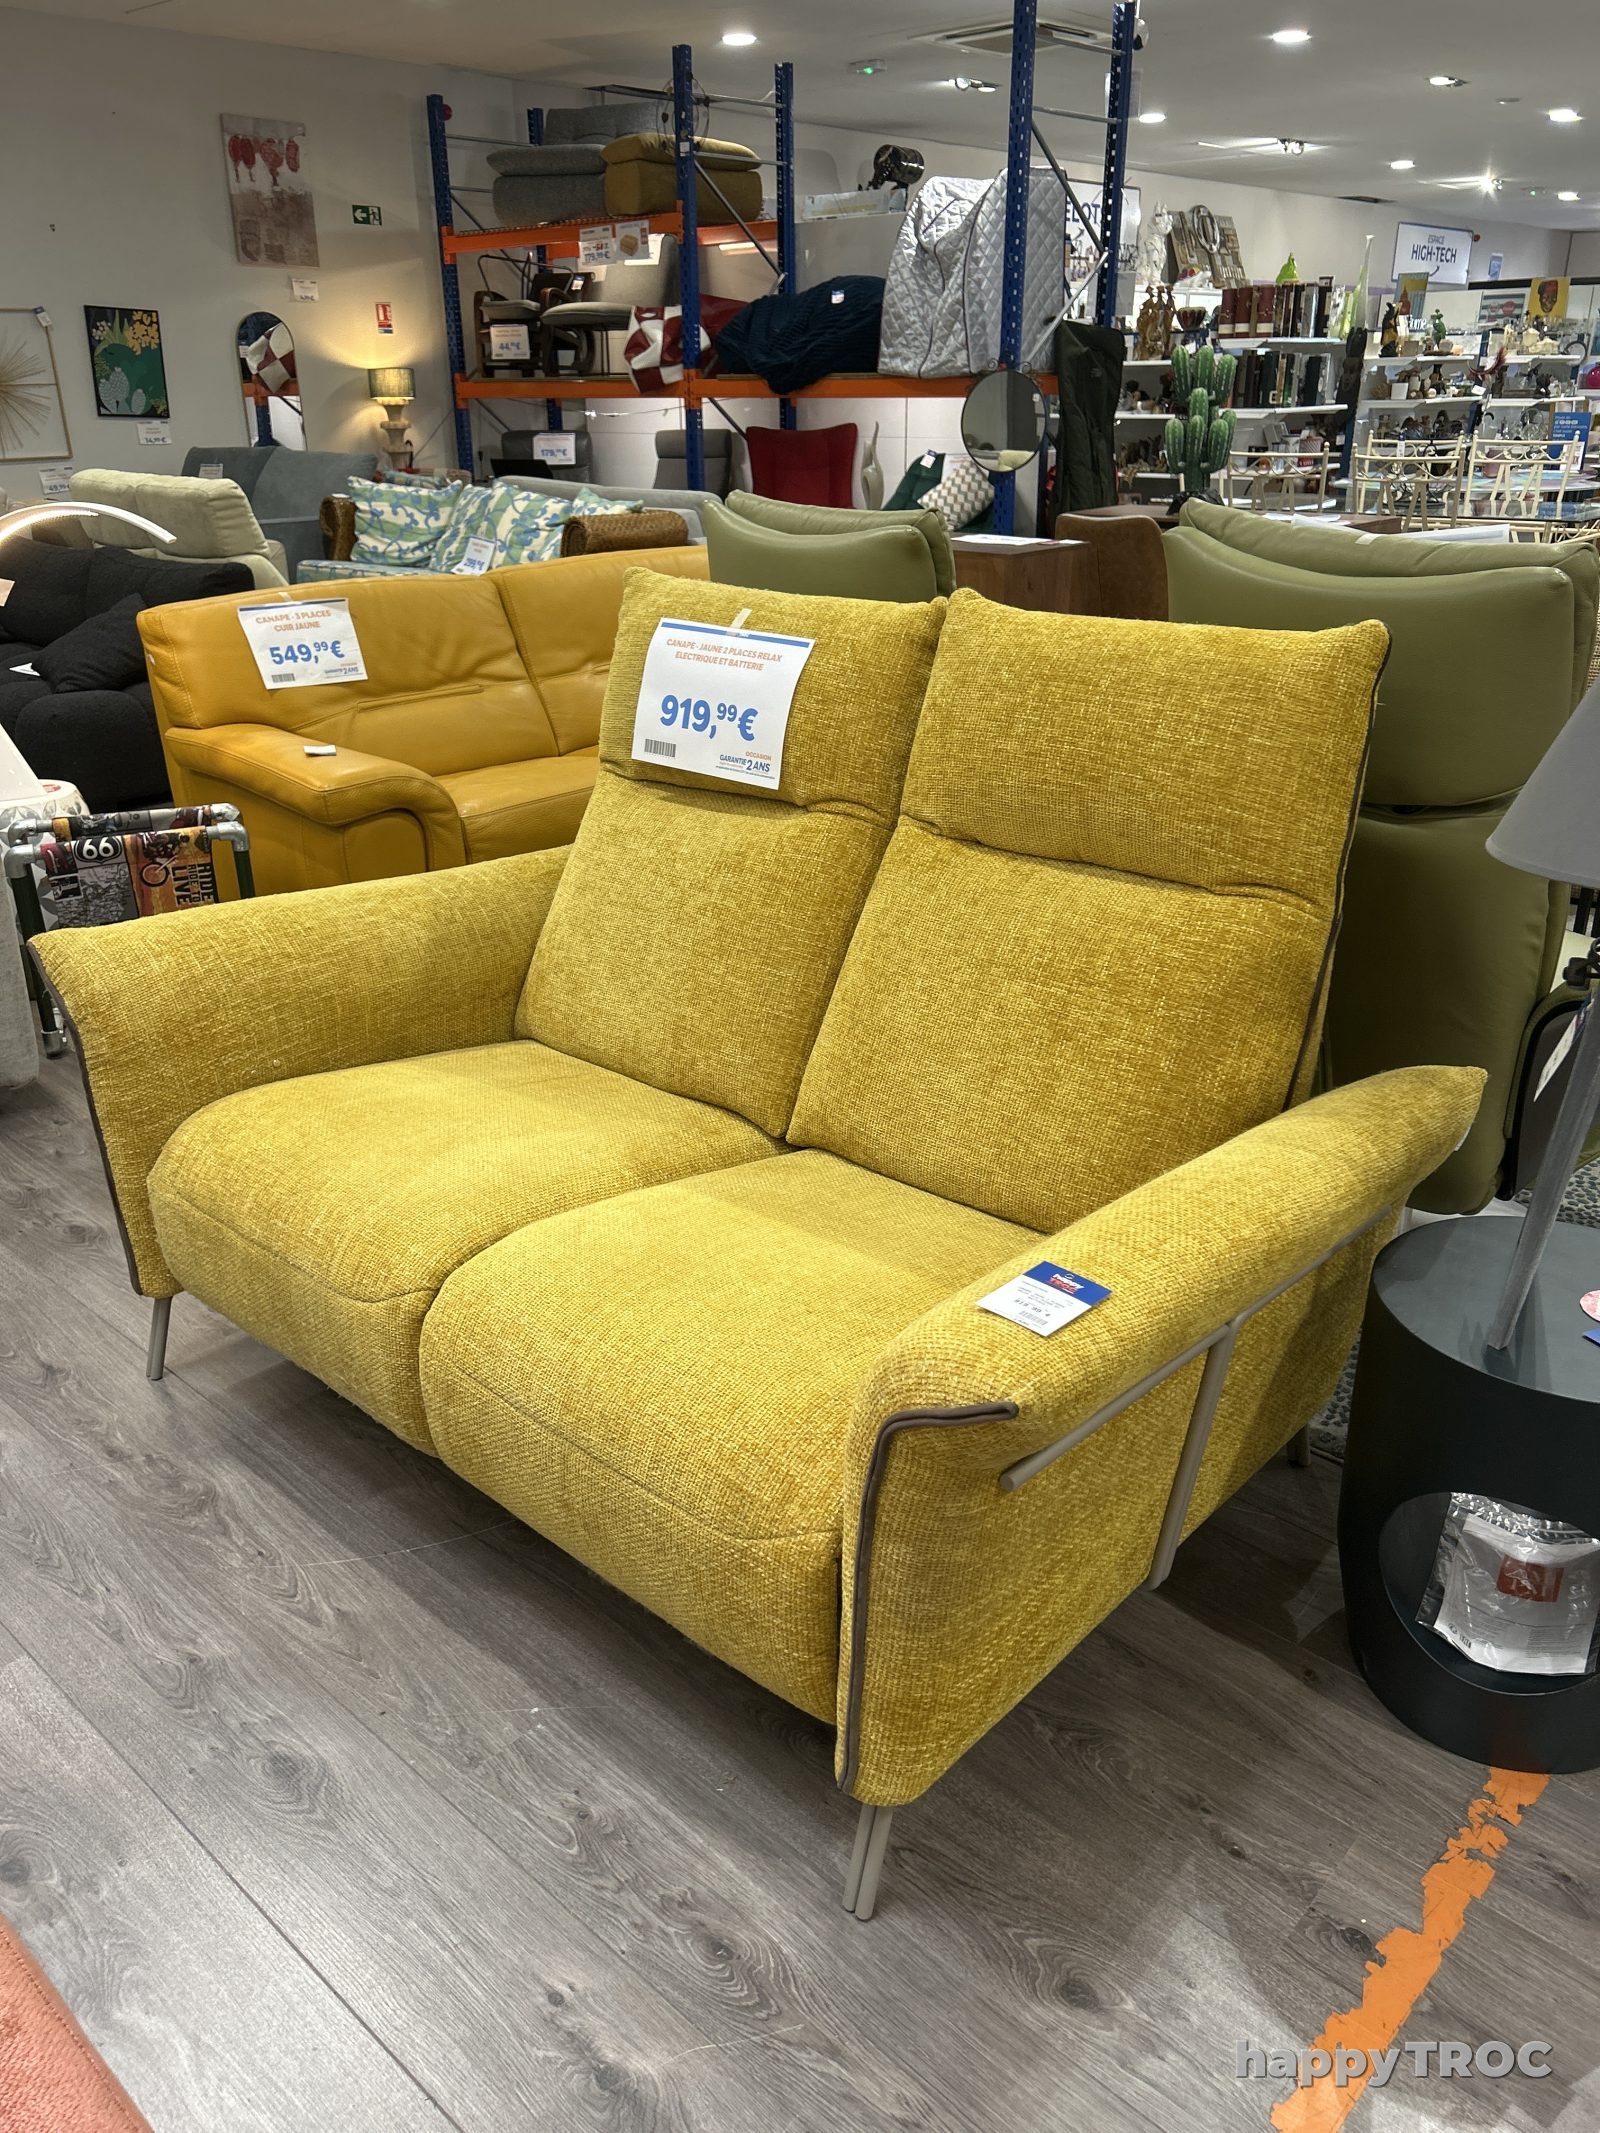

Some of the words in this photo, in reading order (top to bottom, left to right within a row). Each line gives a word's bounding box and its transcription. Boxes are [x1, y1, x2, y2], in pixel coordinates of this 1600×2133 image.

[1428, 234, 1445, 245] ESPACE
[1411, 244, 1457, 264] HIGH-TECH
[256, 613, 289, 624] CANAPE
[301, 609, 332, 619] PLACES
[274, 623, 294, 632] CUIR
[295, 621, 321, 630] JAUNE
[666, 638, 697, 649] CANAPE
[699, 643, 723, 653] JAUNE
[723, 646, 729, 654] 2
[728, 647, 758, 659] PLACES
[757, 652, 783, 662] RELAX
[675, 651, 718, 665] ELECTRIQUE
[719, 657, 728, 666] ET
[728, 659, 765, 671] BATTERIE
[720, 754, 747, 766] GARANTIE
[746, 759, 753, 771] 2
[752, 761, 771, 772] ANS
[745, 751, 772, 761] OCCASION
[82, 836, 117, 861] 66
[187, 864, 199, 886] RIDE
[171, 865, 192, 906] LIVE
[190, 892, 201, 903] TO
